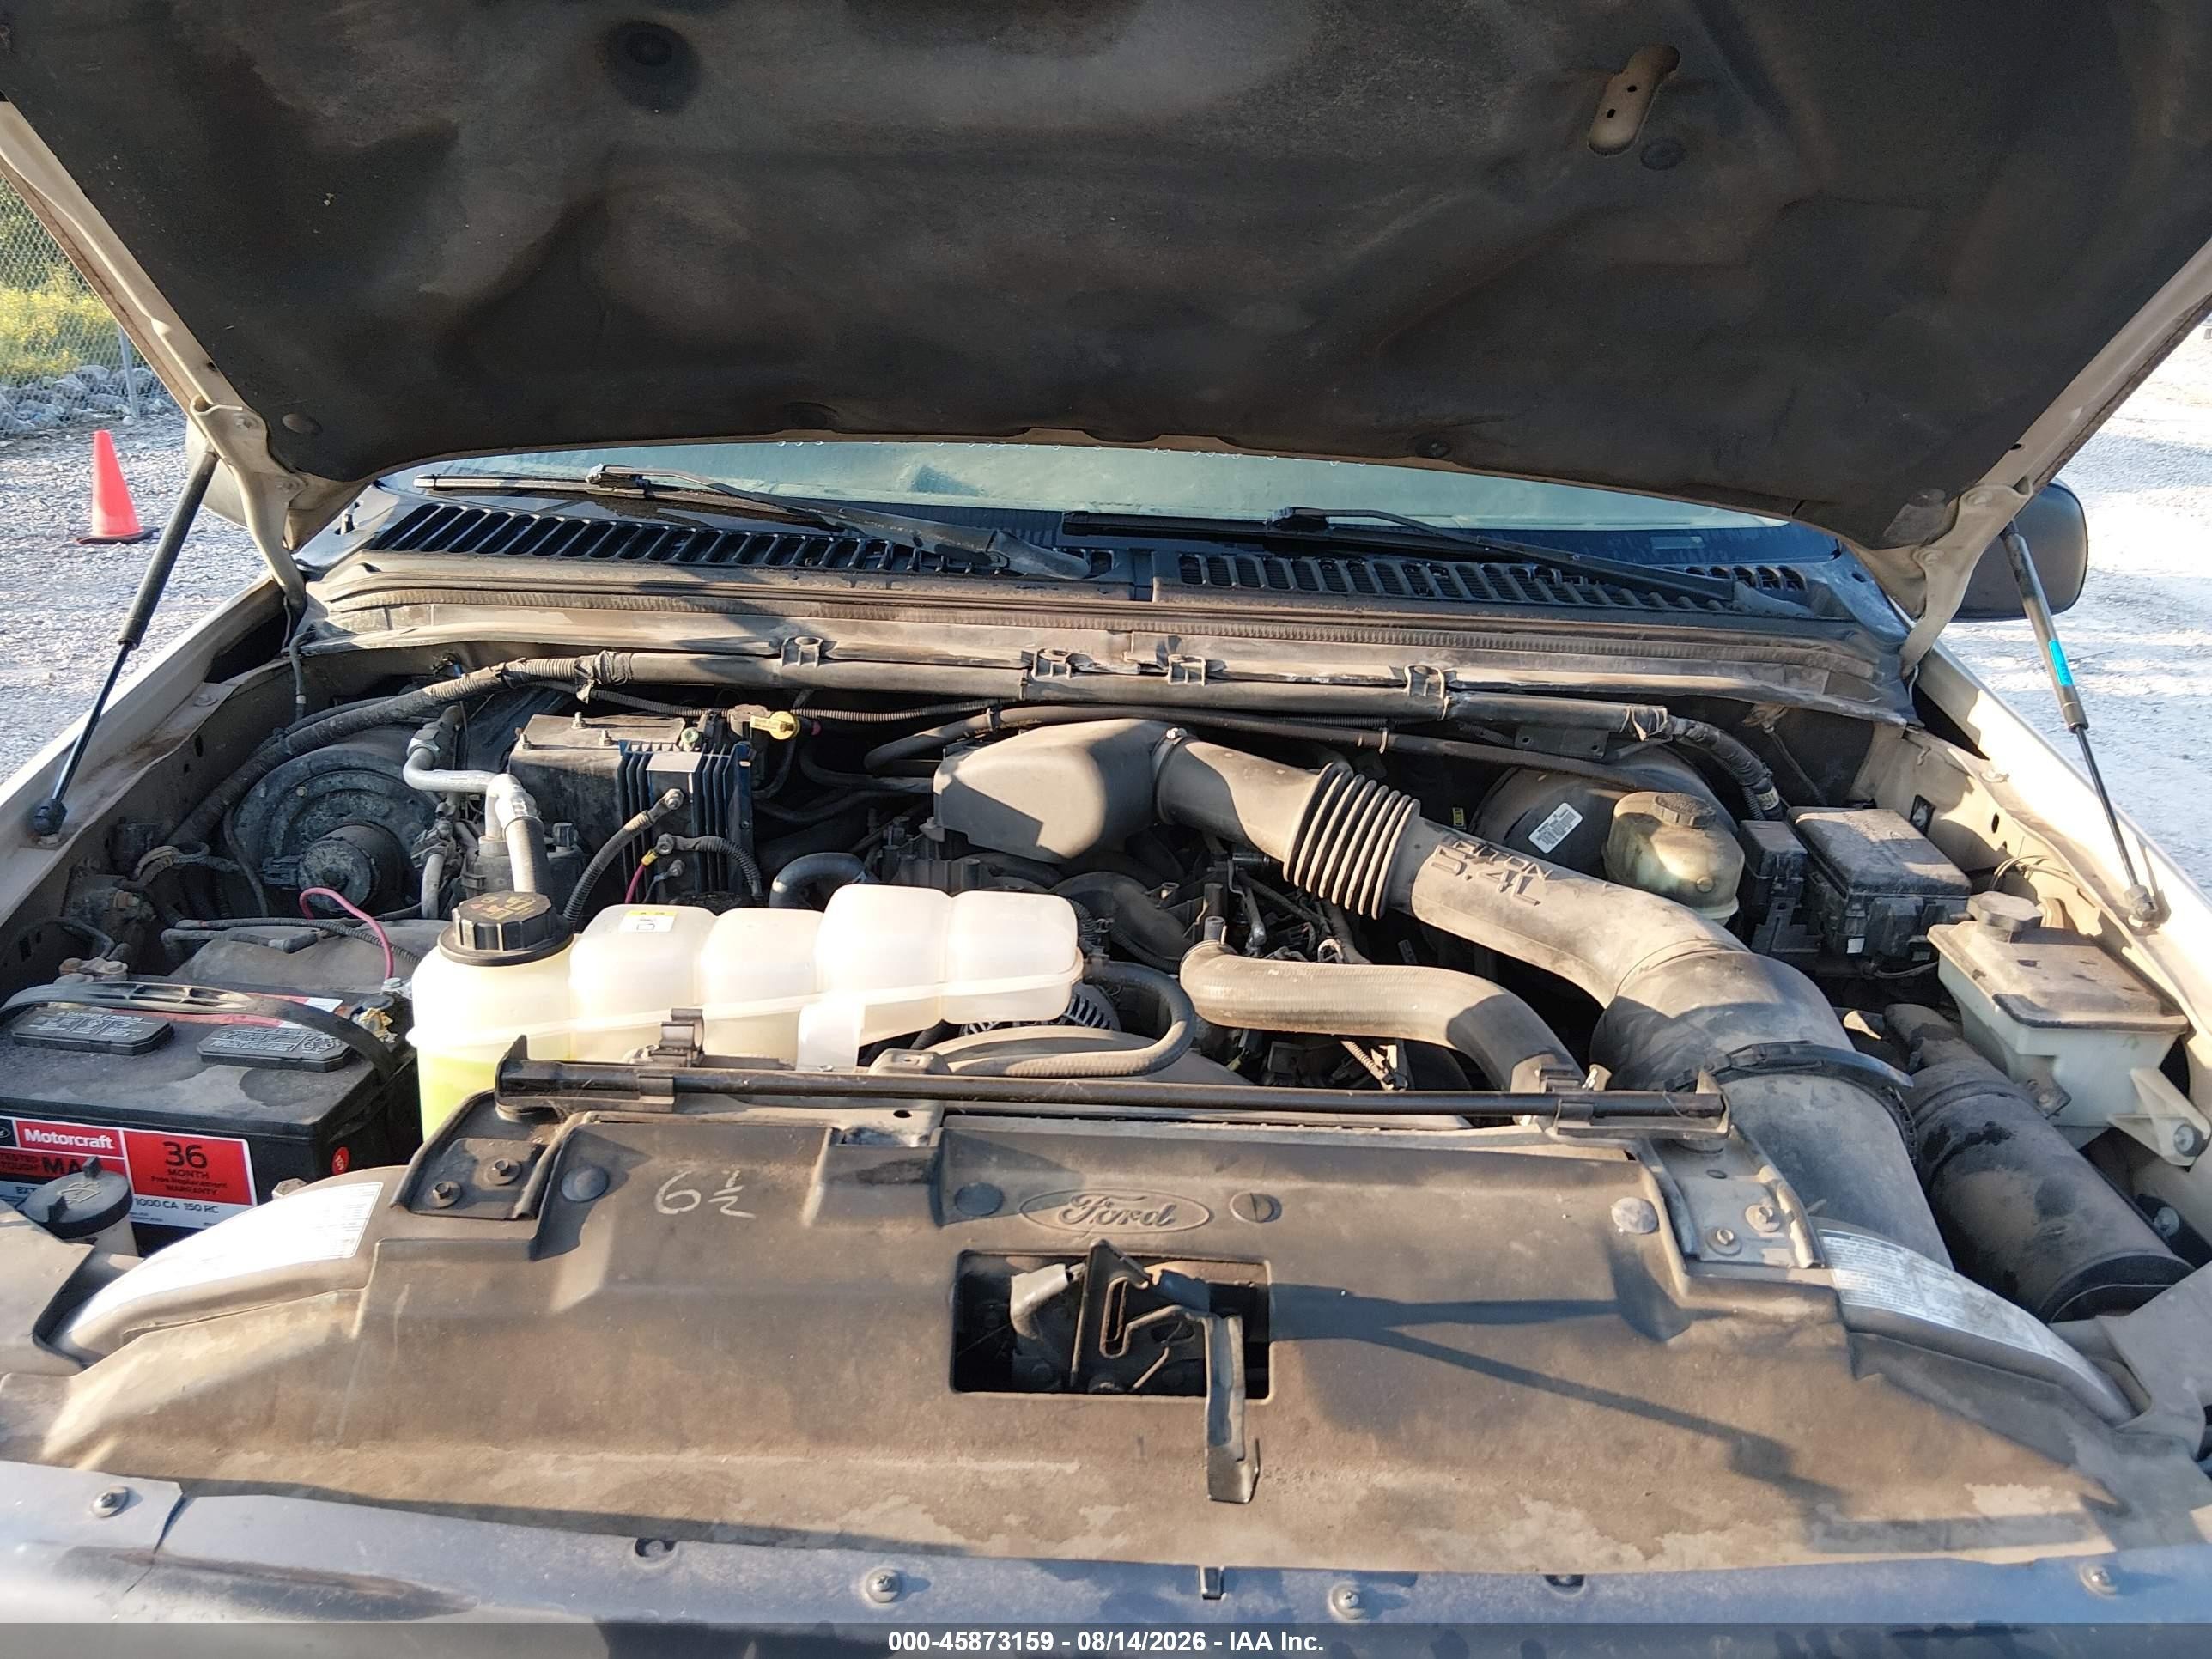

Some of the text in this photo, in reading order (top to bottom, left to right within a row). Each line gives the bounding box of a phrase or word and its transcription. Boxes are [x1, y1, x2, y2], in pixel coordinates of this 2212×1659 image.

[1430, 845, 1541, 907] 5.4L
[24, 1128, 116, 1150] Motorcraft
[41, 1156, 83, 1174] MA
[163, 1141, 207, 1169] 36
[167, 1169, 210, 1179] MONTH
[165, 1185, 218, 1195] WARRANTY
[135, 1198, 161, 1206] 1000
[162, 1200, 179, 1209] CA
[204, 1206, 219, 1214] RC
[1059, 1193, 1177, 1227] Ford
